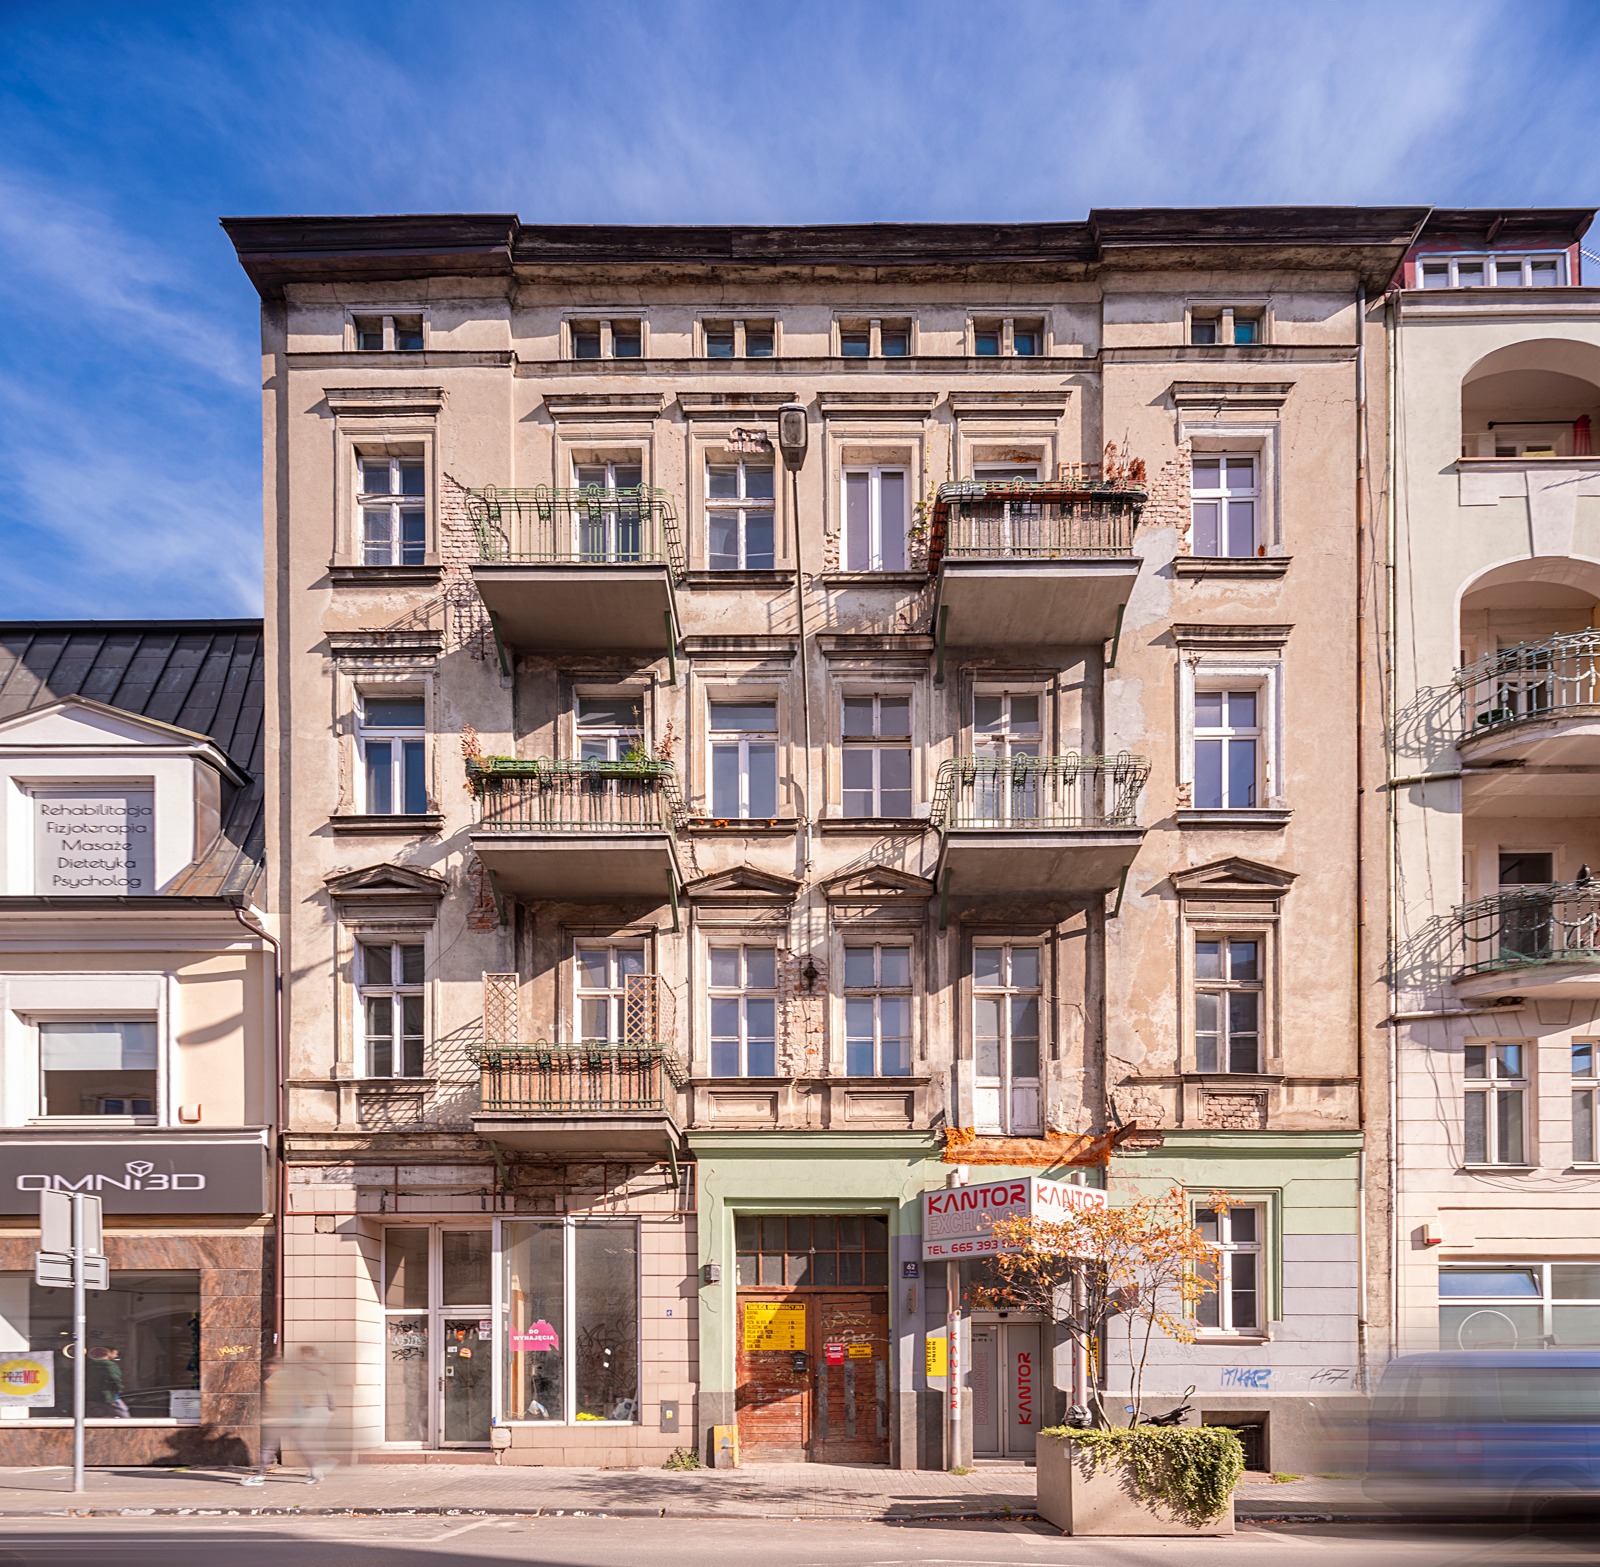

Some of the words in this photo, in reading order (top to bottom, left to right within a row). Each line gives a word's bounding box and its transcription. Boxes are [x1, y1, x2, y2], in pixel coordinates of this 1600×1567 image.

[41, 804, 152, 817] Rehabilitacja
[46, 822, 147, 835] Fizjoterapia
[62, 838, 133, 851] Masaże
[57, 857, 136, 871] Dietetyka
[52, 875, 142, 888] Psycholog
[928, 1184, 1026, 1215] KANTOR
[1037, 1184, 1105, 1214] KANTOR
[927, 1246, 948, 1255] TEL.
[951, 1243, 973, 1253] 665
[977, 1240, 998, 1251] 393
[950, 1332, 959, 1409] KANTOR
[975, 1352, 988, 1425] EXCHANGE
[1017, 1352, 1032, 1425] KANTOR
